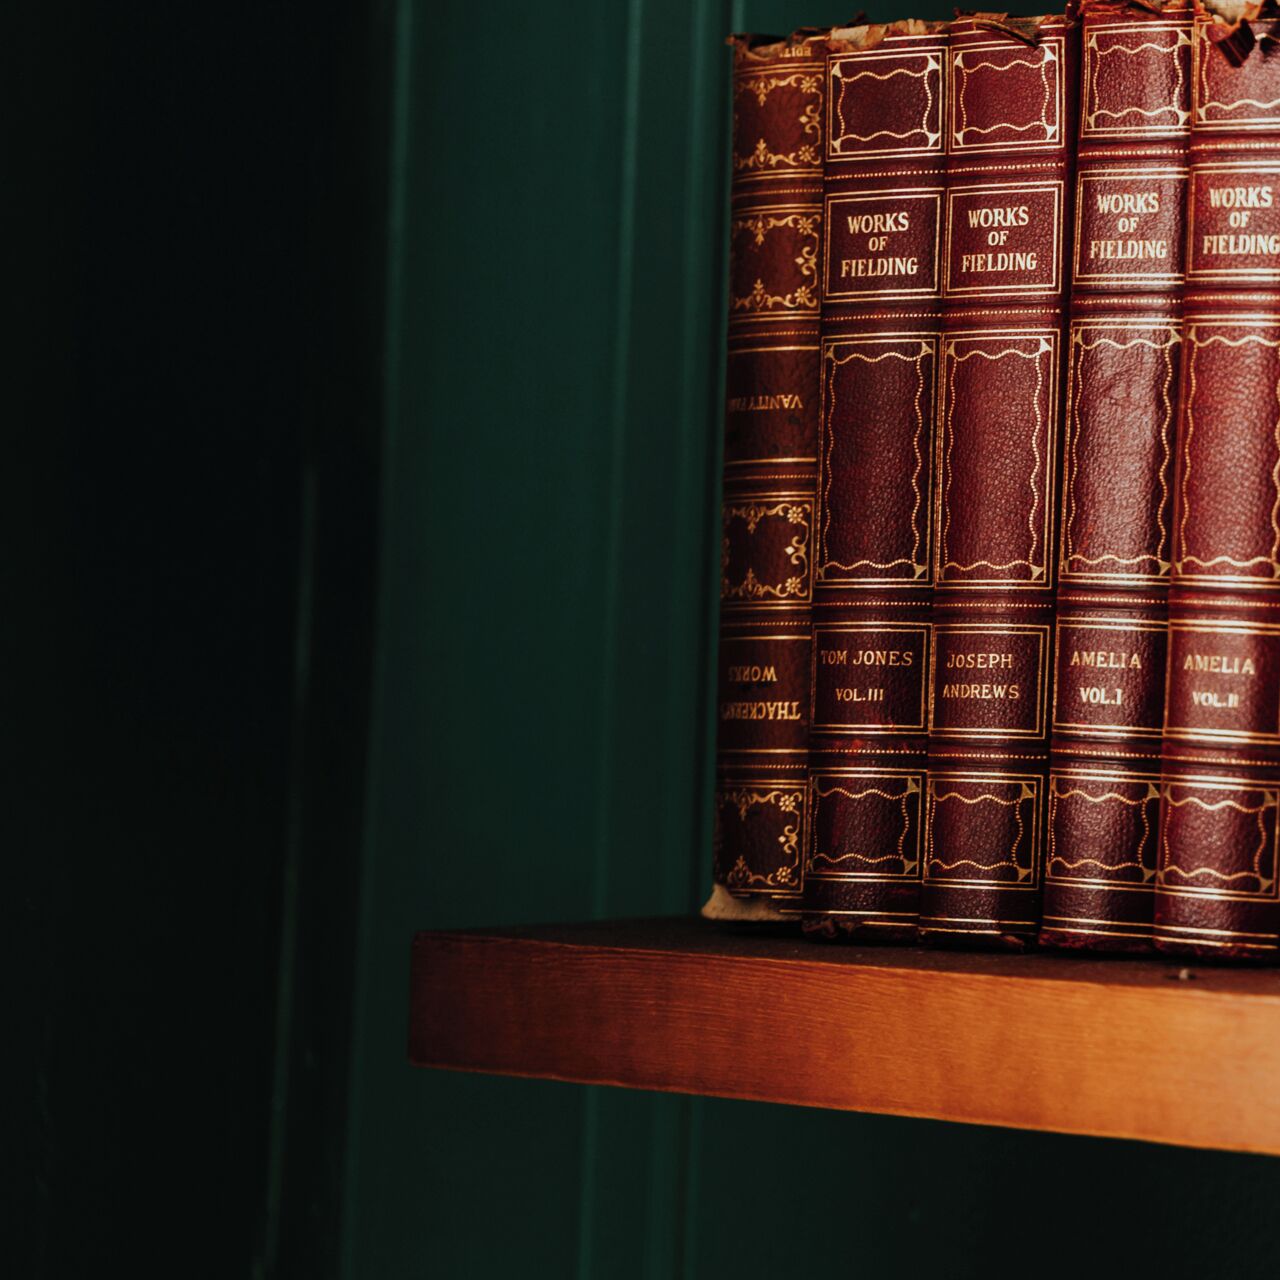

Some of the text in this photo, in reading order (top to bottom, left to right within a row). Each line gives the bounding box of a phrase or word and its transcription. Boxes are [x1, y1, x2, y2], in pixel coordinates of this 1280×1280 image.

[1096, 192, 1160, 214] WORKS
[1209, 186, 1273, 208] WORKS
[847, 211, 910, 234] WORKS
[968, 206, 1030, 228] WORKS
[1118, 217, 1140, 233] OF
[1229, 211, 1251, 228] OF
[868, 236, 888, 252] OF
[987, 230, 1010, 246] OF
[1202, 234, 1280, 255] FIELDING
[1090, 240, 1168, 259] FIELDING
[840, 257, 919, 278] FIELDING
[961, 252, 1038, 273] FIELDING
[748, 394, 804, 410] VANITY
[821, 650, 913, 667] TOM JONES
[946, 653, 1013, 669] JOSEPH
[1070, 650, 1142, 669] AMELIA
[1183, 654, 1256, 675] AMELIA
[728, 665, 778, 682] WORKS
[835, 687, 884, 702] VOL.III
[942, 683, 1020, 700] ANDREWS
[1079, 687, 1123, 705] VOL.I
[1192, 691, 1239, 708] VOL.II
